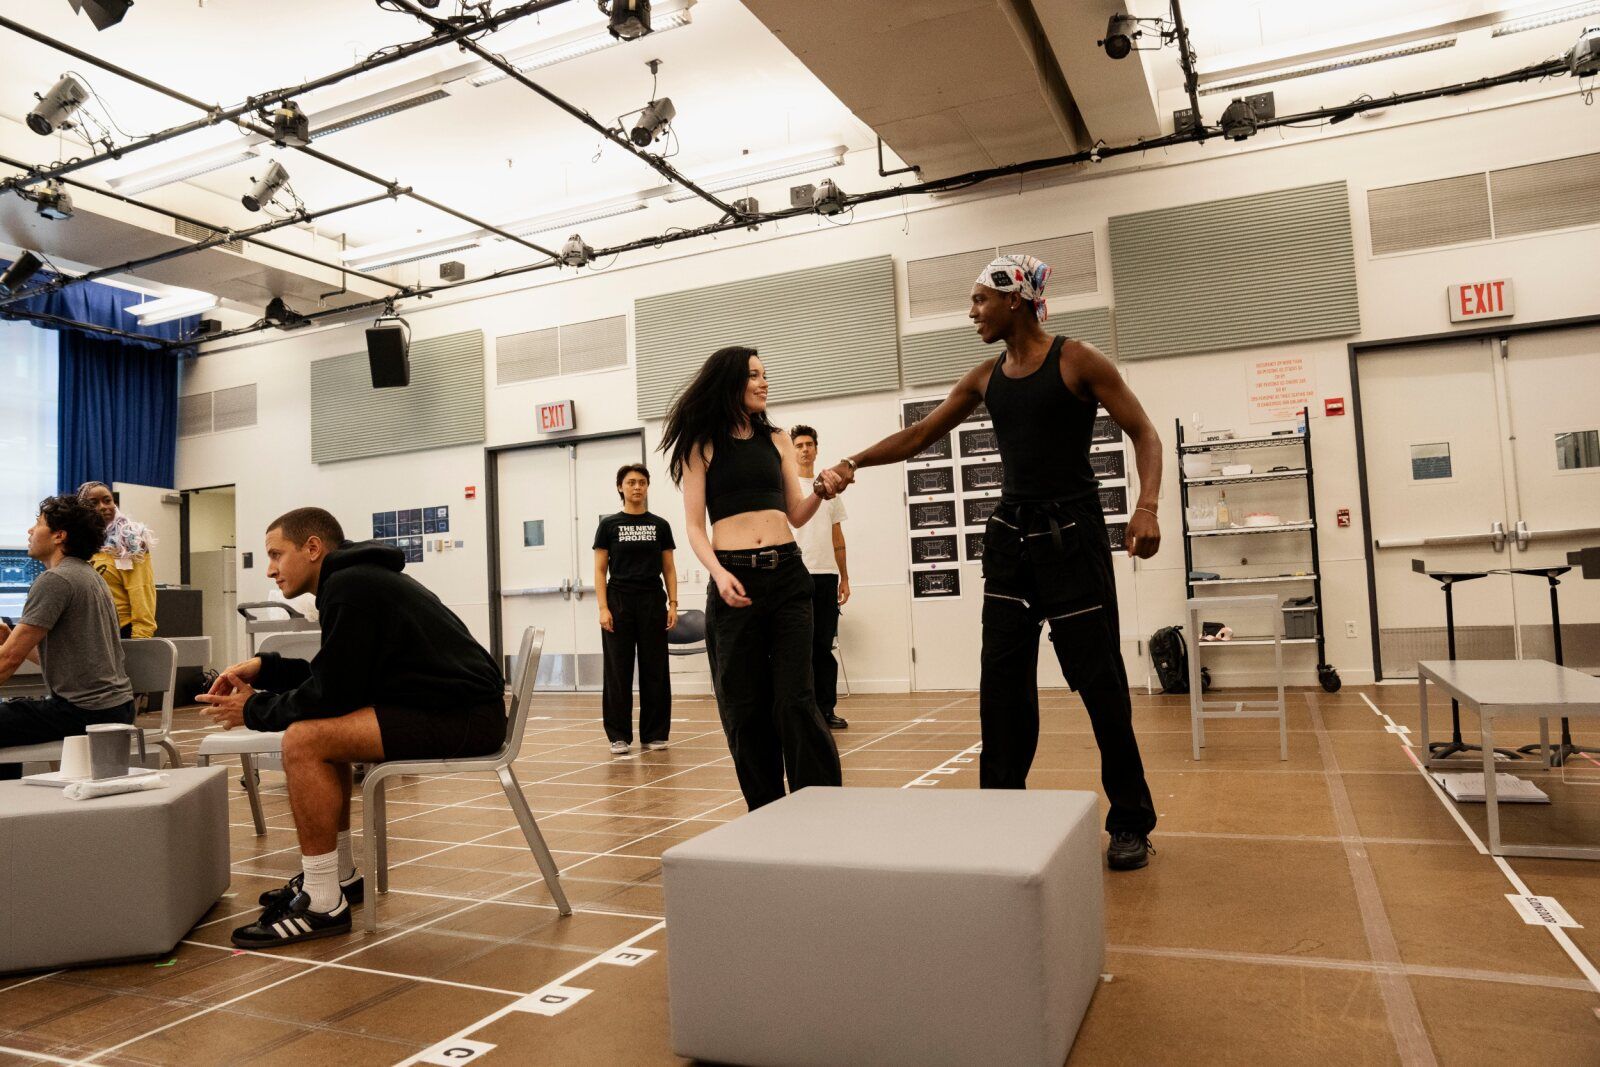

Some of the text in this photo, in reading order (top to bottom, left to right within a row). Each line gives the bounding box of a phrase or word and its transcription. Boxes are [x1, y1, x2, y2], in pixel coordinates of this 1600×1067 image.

[1460, 281, 1504, 315] EXIT
[541, 404, 564, 428] EXIT
[615, 952, 642, 961] E
[539, 994, 569, 1004] D
[443, 1047, 475, 1059] C
